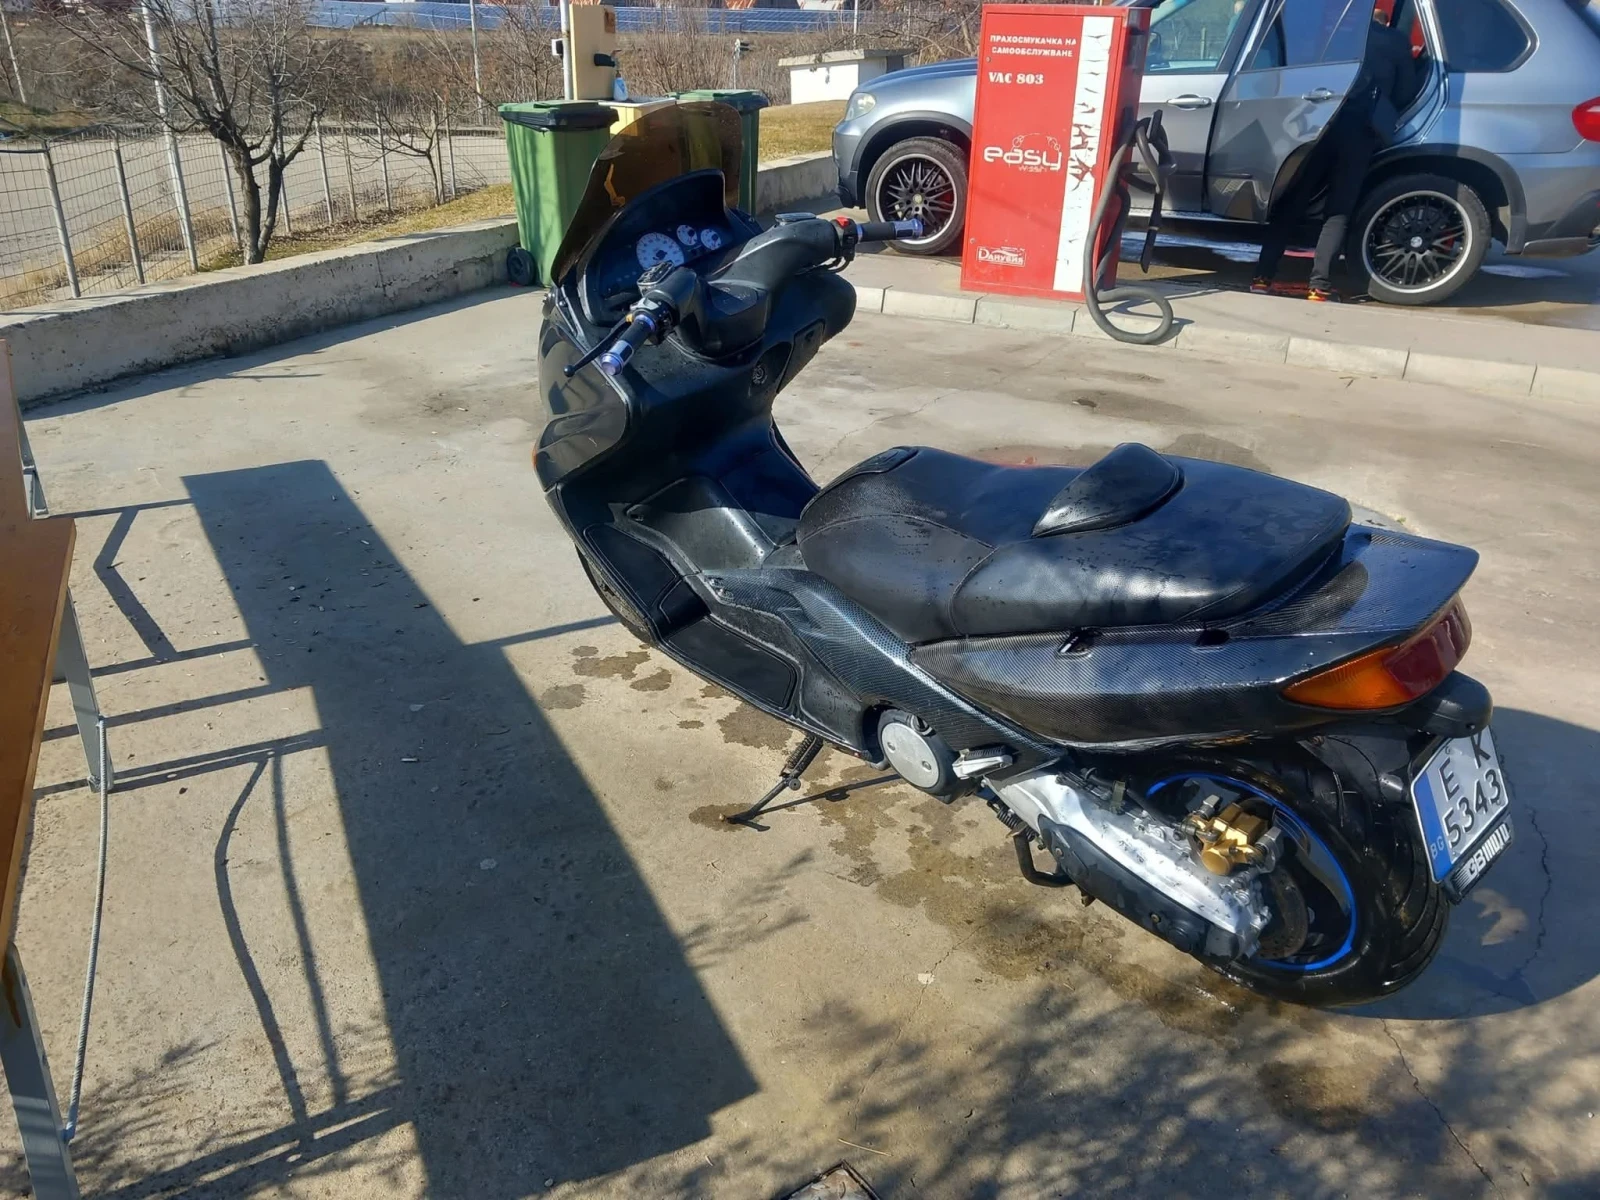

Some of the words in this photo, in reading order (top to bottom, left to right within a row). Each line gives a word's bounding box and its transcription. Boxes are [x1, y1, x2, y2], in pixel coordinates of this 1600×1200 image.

[990, 35, 1063, 45] ПРАХОСМУКАЧКА
[1065, 38, 1077, 46] НА
[992, 47, 1073, 57] САМООБСЛУЖВАНЕ
[988, 72, 1012, 84] VAC
[1016, 73, 1044, 85] 803
[983, 146, 1062, 171] easy
[1442, 769, 1501, 849] 5343
[1430, 836, 1445, 859] BG
